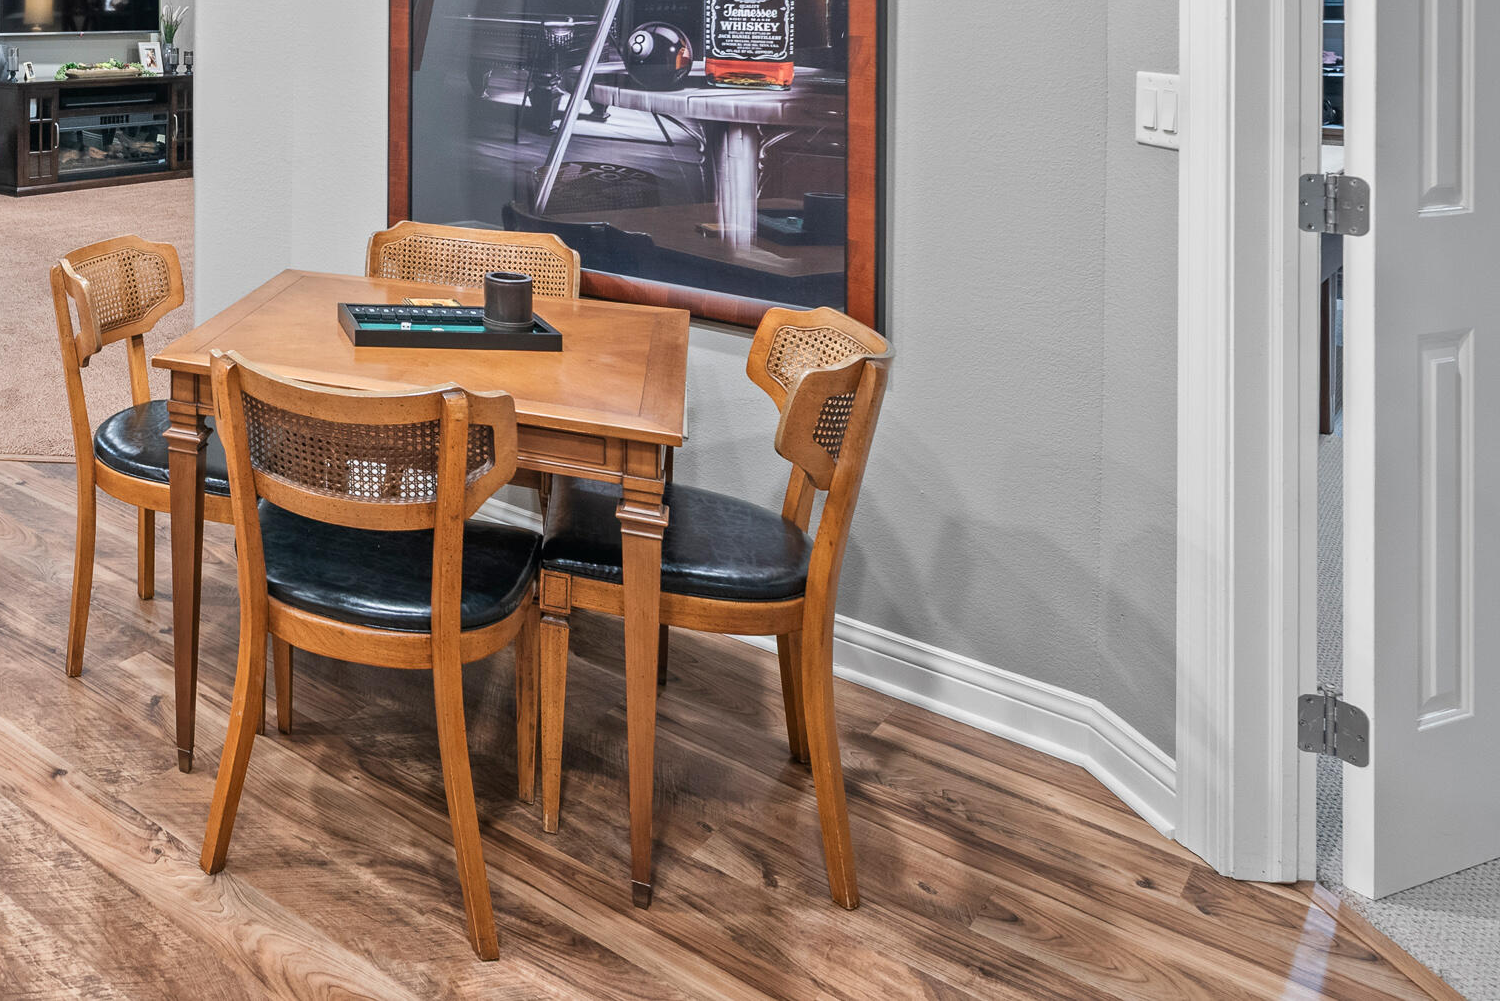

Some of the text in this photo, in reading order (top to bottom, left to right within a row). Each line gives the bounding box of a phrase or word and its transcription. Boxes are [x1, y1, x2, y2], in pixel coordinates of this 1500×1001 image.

[723, 3, 778, 18] Tennessee
[719, 21, 780, 32] WHISKEY
[631, 34, 646, 55] 8
